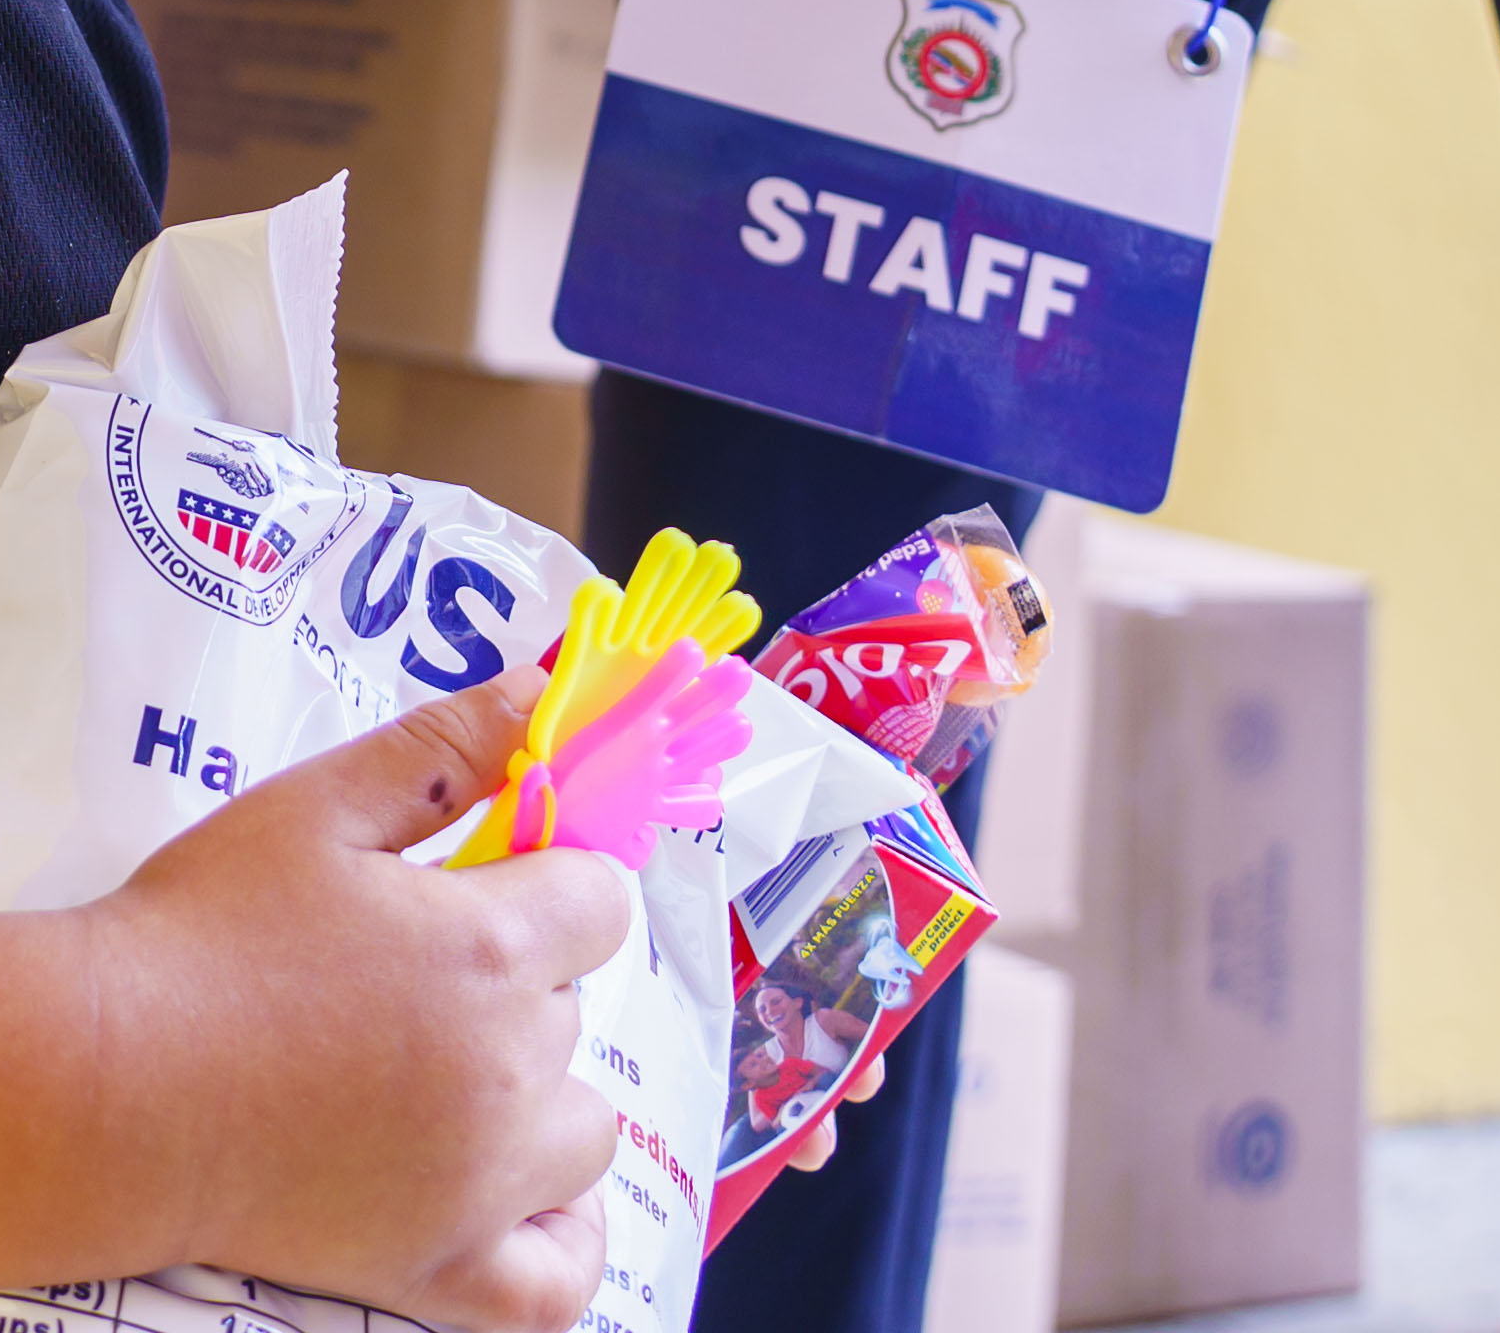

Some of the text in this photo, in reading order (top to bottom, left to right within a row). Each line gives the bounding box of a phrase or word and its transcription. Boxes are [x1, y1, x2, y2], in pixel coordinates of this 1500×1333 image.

[740, 175, 1090, 341] STAFF
[114, 424, 336, 619] INTERNATIONAL DEVELOPMENT
[878, 538, 931, 572] Edad
[799, 939, 818, 959] 4X
[812, 917, 837, 943] MÁS
[911, 906, 953, 957] con Calci-
[929, 909, 966, 952] protect
